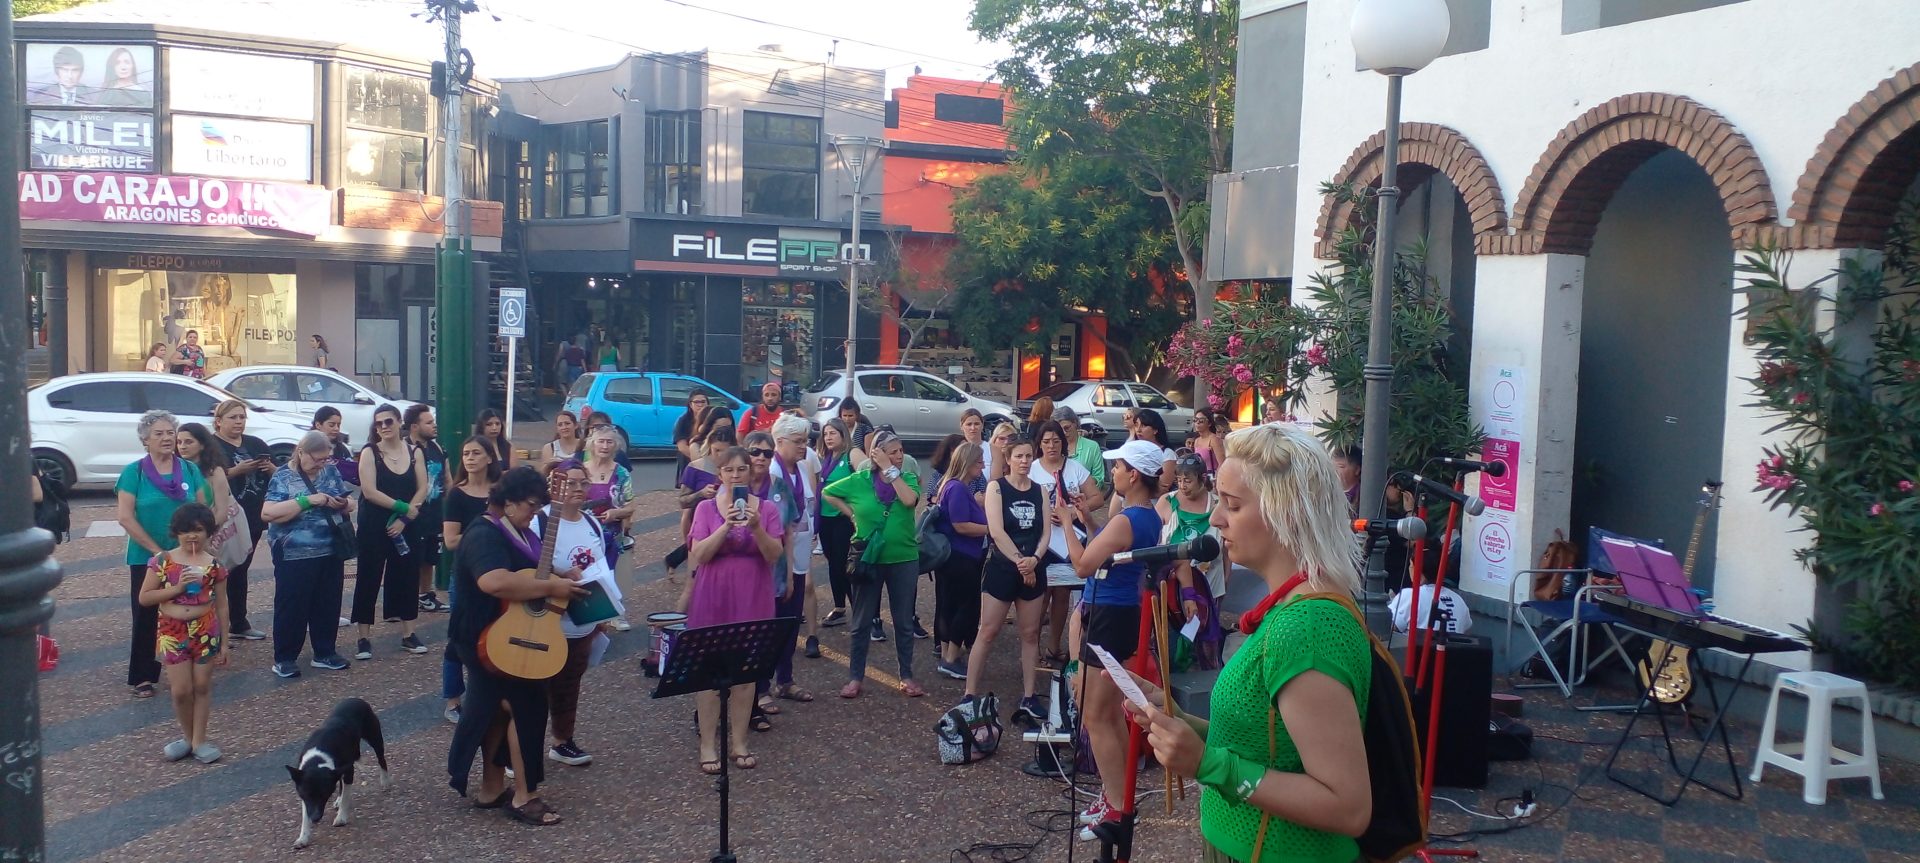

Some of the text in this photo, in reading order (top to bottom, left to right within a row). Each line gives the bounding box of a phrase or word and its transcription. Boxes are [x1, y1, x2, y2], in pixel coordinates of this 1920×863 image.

[34, 120, 151, 147] MILEI
[75, 146, 109, 154] Victoria
[40, 153, 147, 169] VILLARRUEL
[18, 173, 63, 203] AD
[72, 174, 229, 209] CARAJO
[103, 206, 202, 223] ARAGONES
[127, 255, 185, 269] FILEPPO
